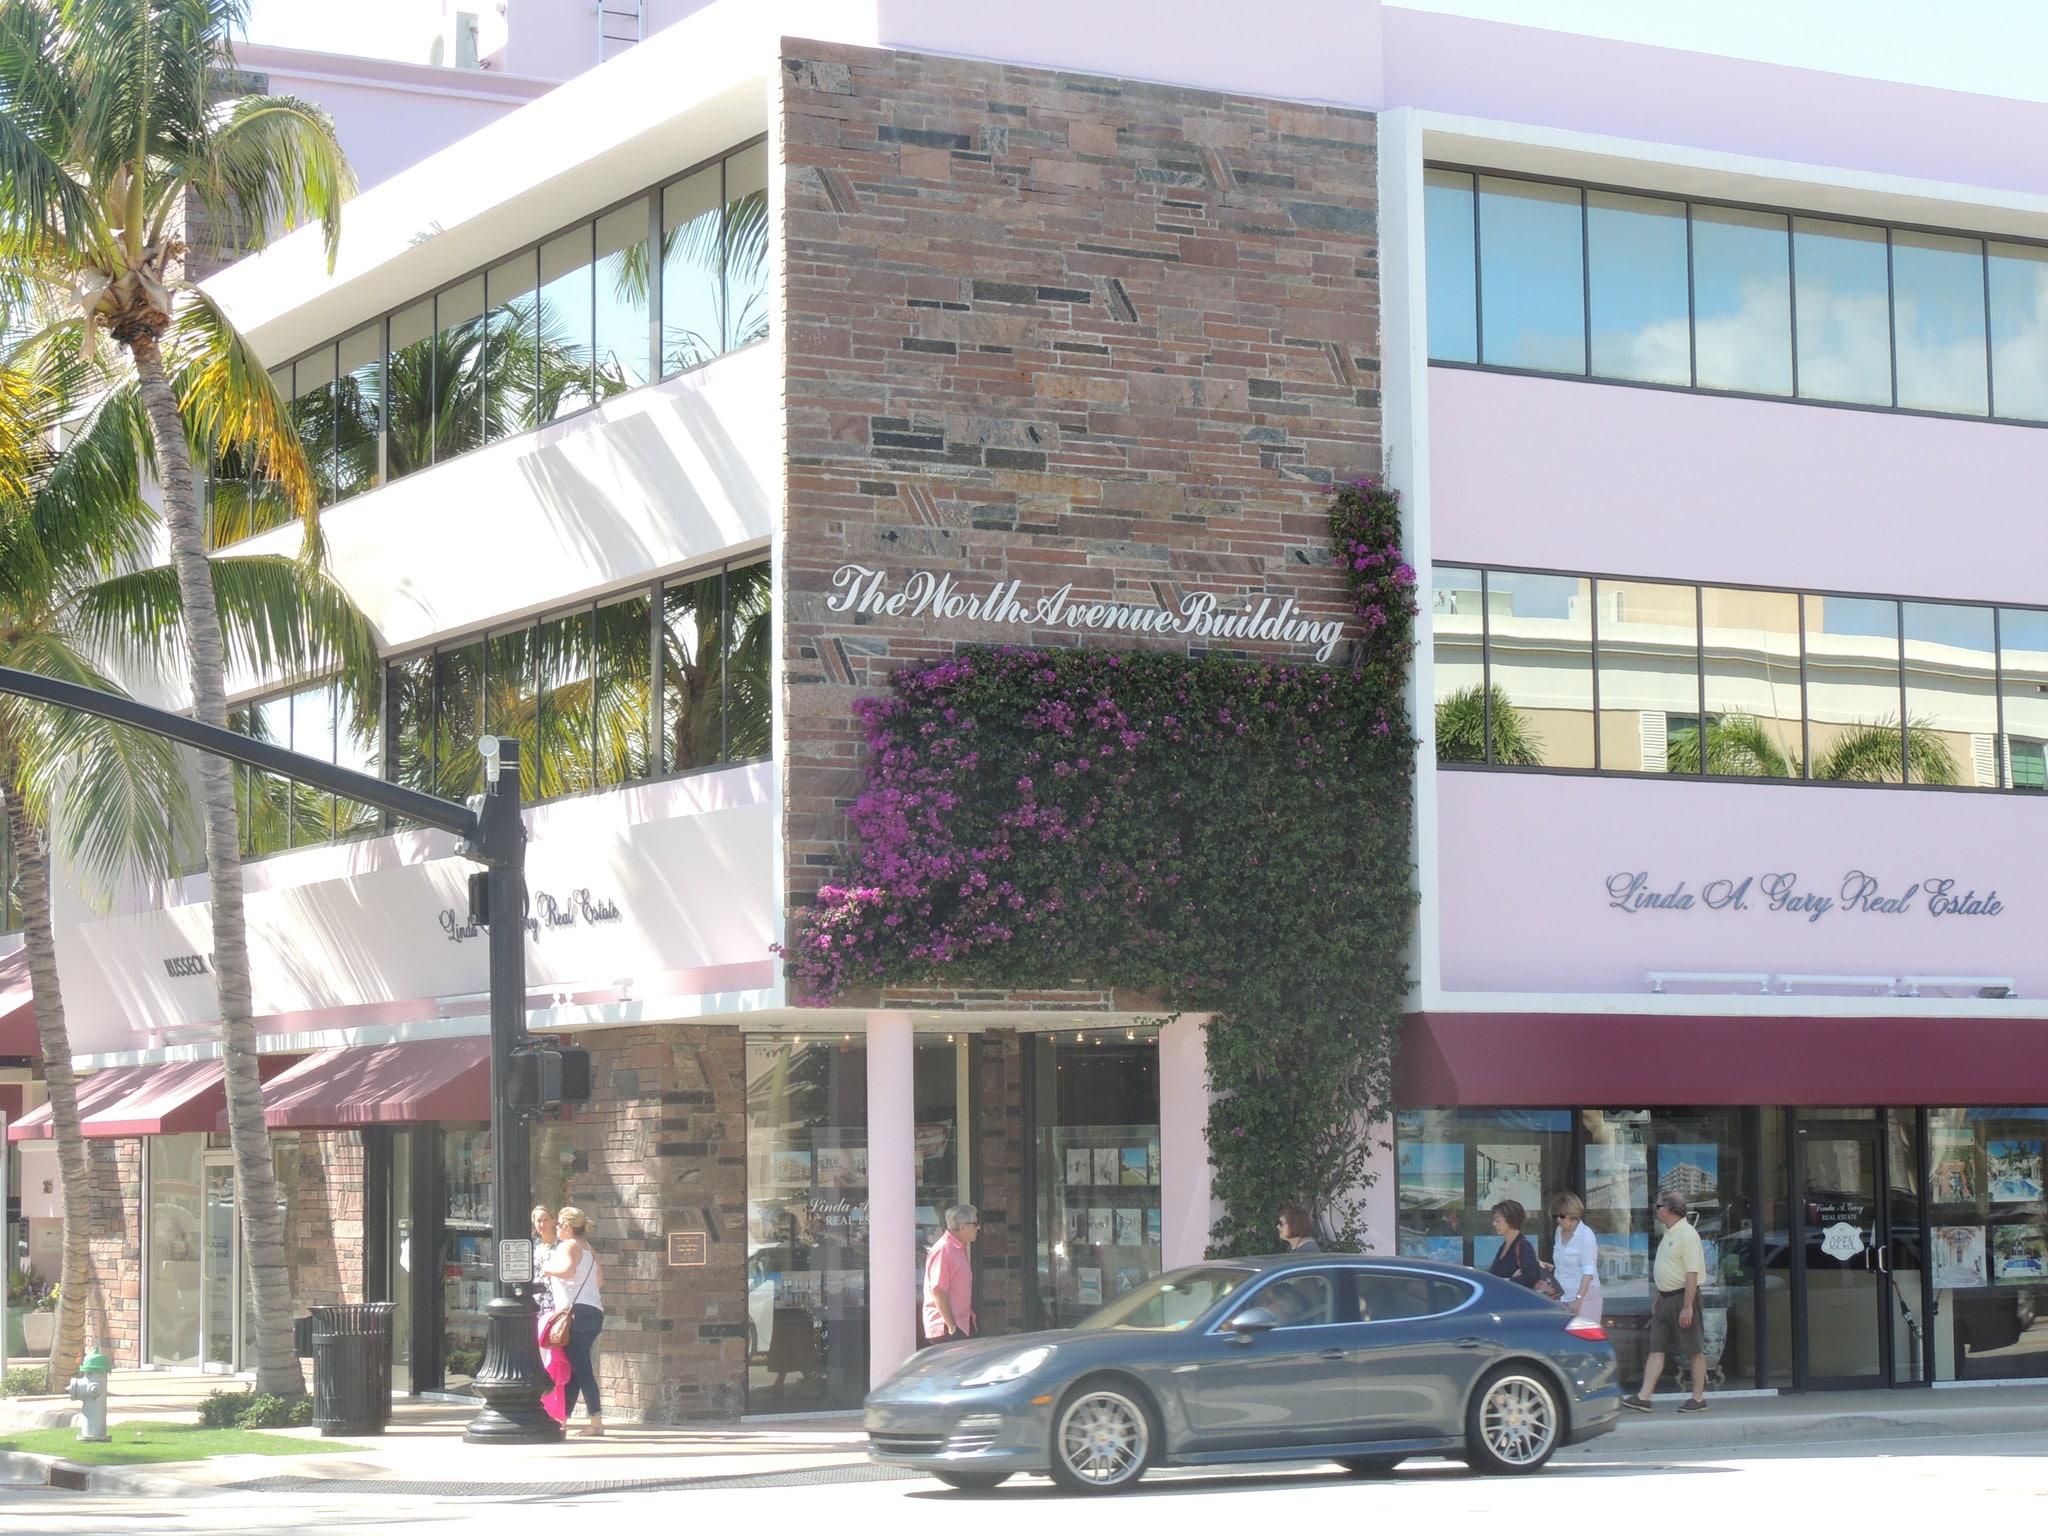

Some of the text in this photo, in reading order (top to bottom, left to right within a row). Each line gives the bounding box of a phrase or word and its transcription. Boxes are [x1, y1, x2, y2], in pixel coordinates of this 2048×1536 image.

[827, 564, 1344, 663] The Worth Avenue Building
[535, 891, 574, 928] Real
[572, 888, 620, 925] Estate
[1606, 870, 2004, 922] Linda A. Gary Real Estate
[810, 1197, 850, 1212] Linda
[826, 1215, 852, 1226] REAL
